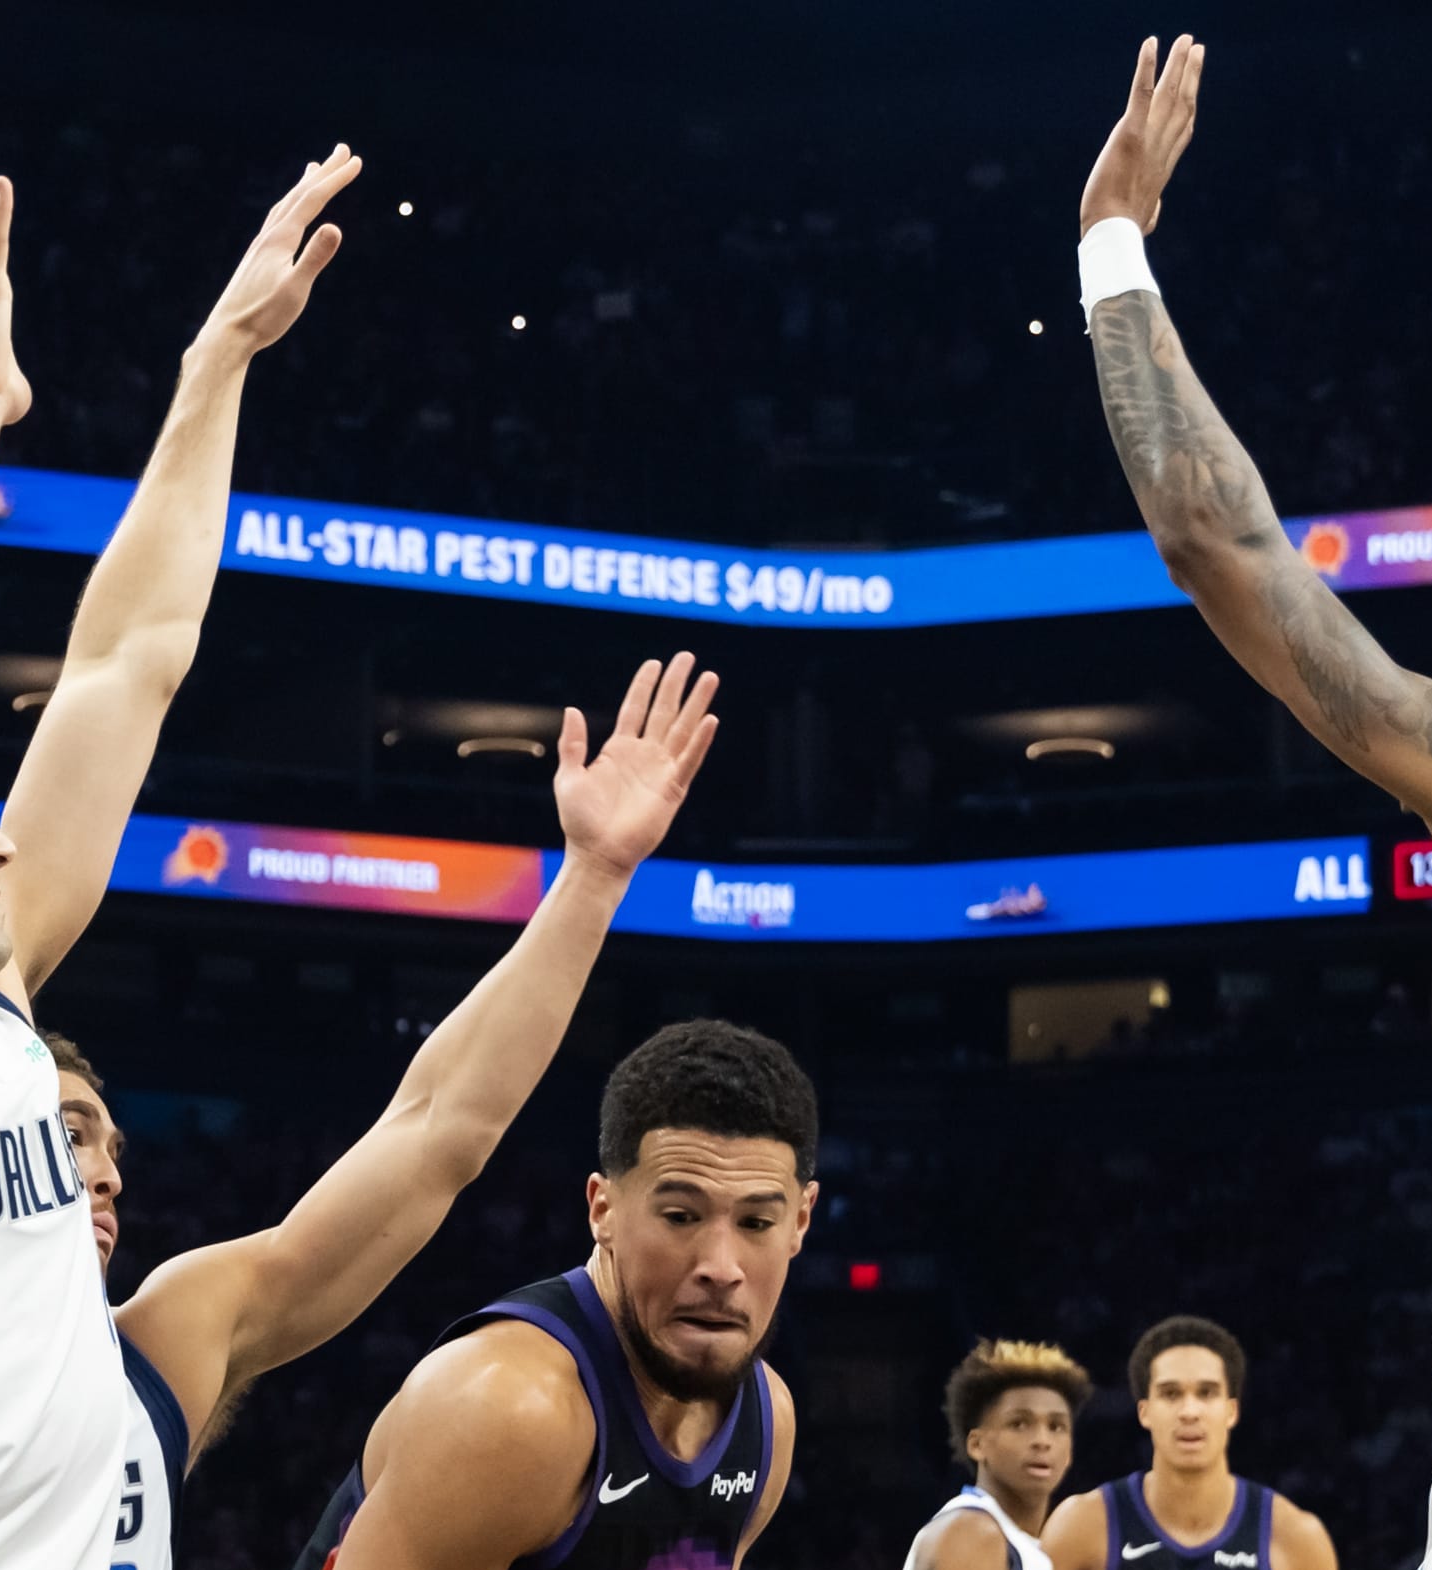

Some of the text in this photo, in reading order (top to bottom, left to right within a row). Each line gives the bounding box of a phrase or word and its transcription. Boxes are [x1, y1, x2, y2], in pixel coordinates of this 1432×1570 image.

[236, 509, 894, 616] ALL-STAR PEST DEFENSE $49/mo
[247, 846, 440, 894] PROUD PARTNER
[1295, 853, 1371, 902] ALL
[710, 1469, 757, 1502] PayPal
